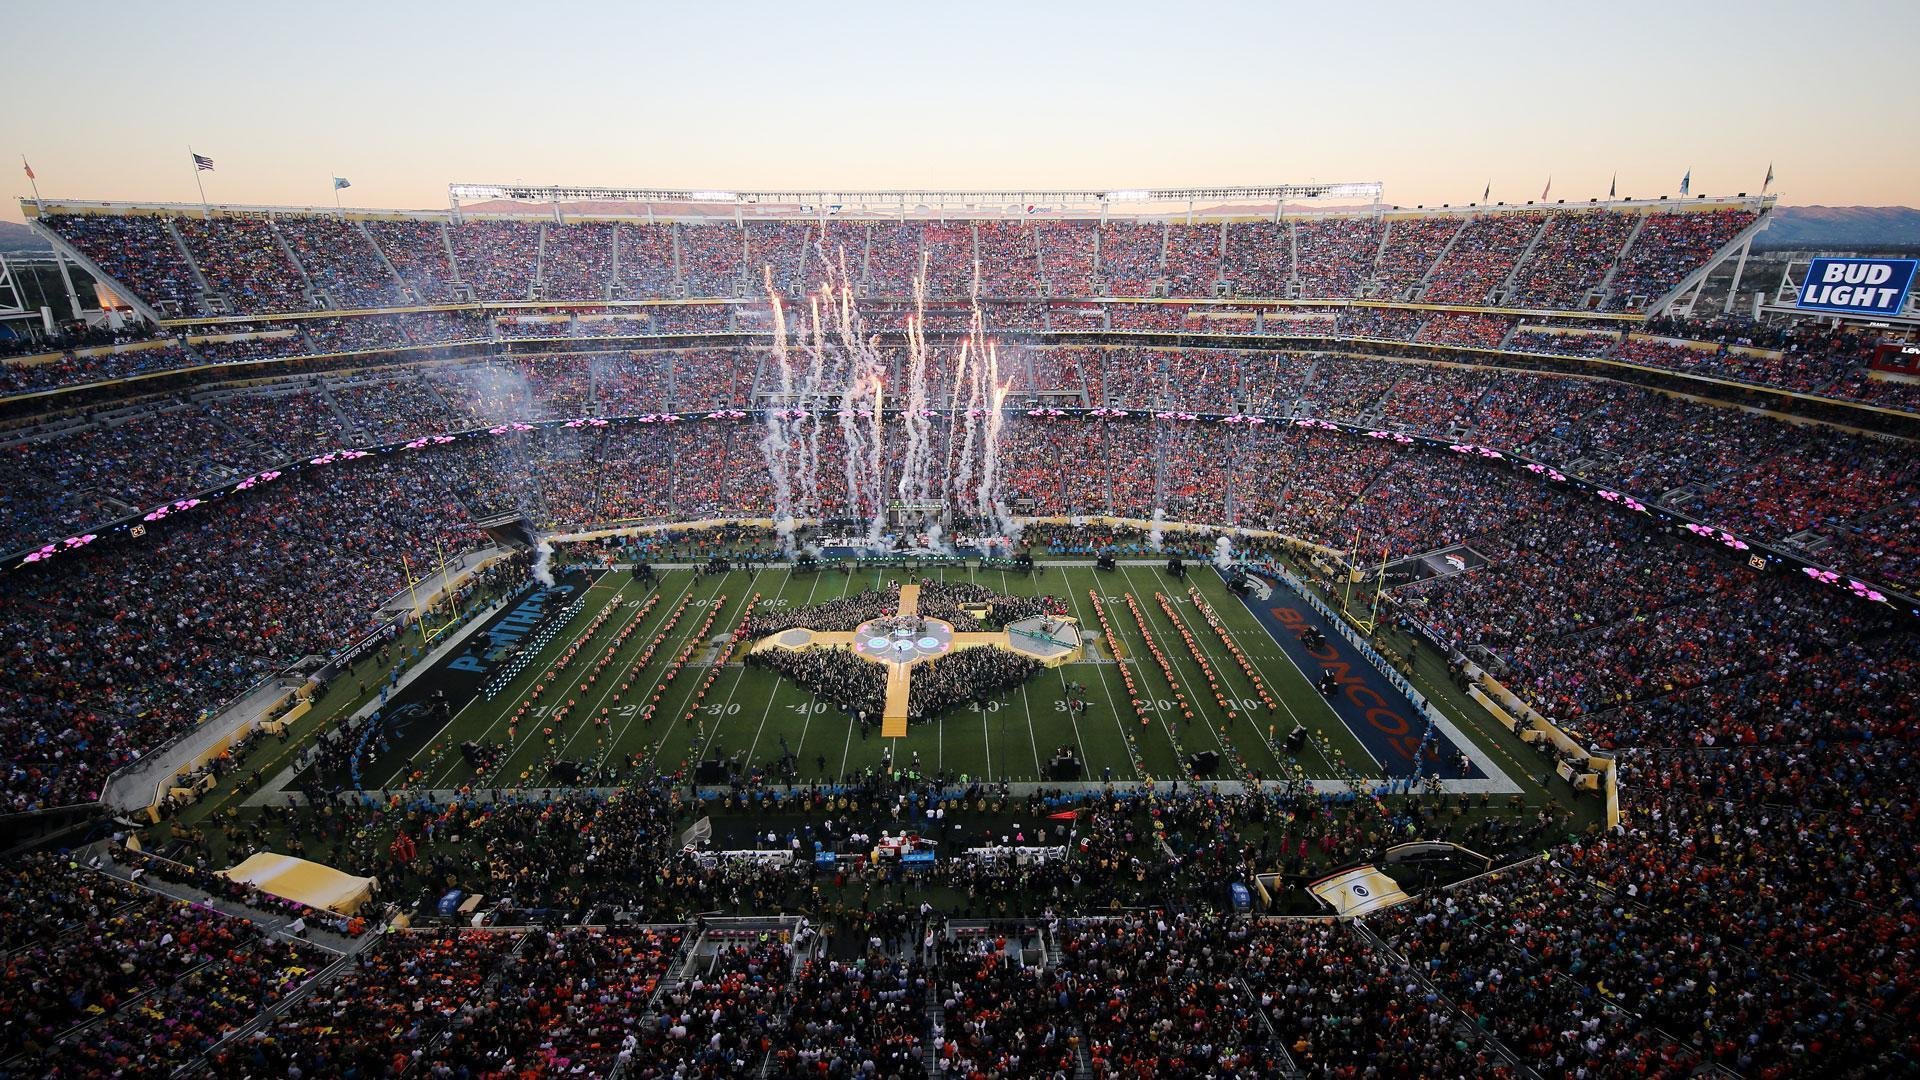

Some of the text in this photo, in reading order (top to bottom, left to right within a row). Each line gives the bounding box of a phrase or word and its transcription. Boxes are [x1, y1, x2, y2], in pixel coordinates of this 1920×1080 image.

[223, 211, 270, 220] SUPER
[275, 212, 312, 220] BOWL
[1500, 210, 1541, 218] SUPER
[1822, 263, 1892, 285] BUD
[1803, 285, 1899, 308] LIGHT
[132, 527, 144, 536] 25
[1751, 557, 1764, 568] 25
[447, 585, 575, 673] PNTHERS
[1403, 612, 1449, 652] SUPER BOWL 50
[336, 648, 362, 669] SUPER
[361, 633, 383, 651] BOWL
